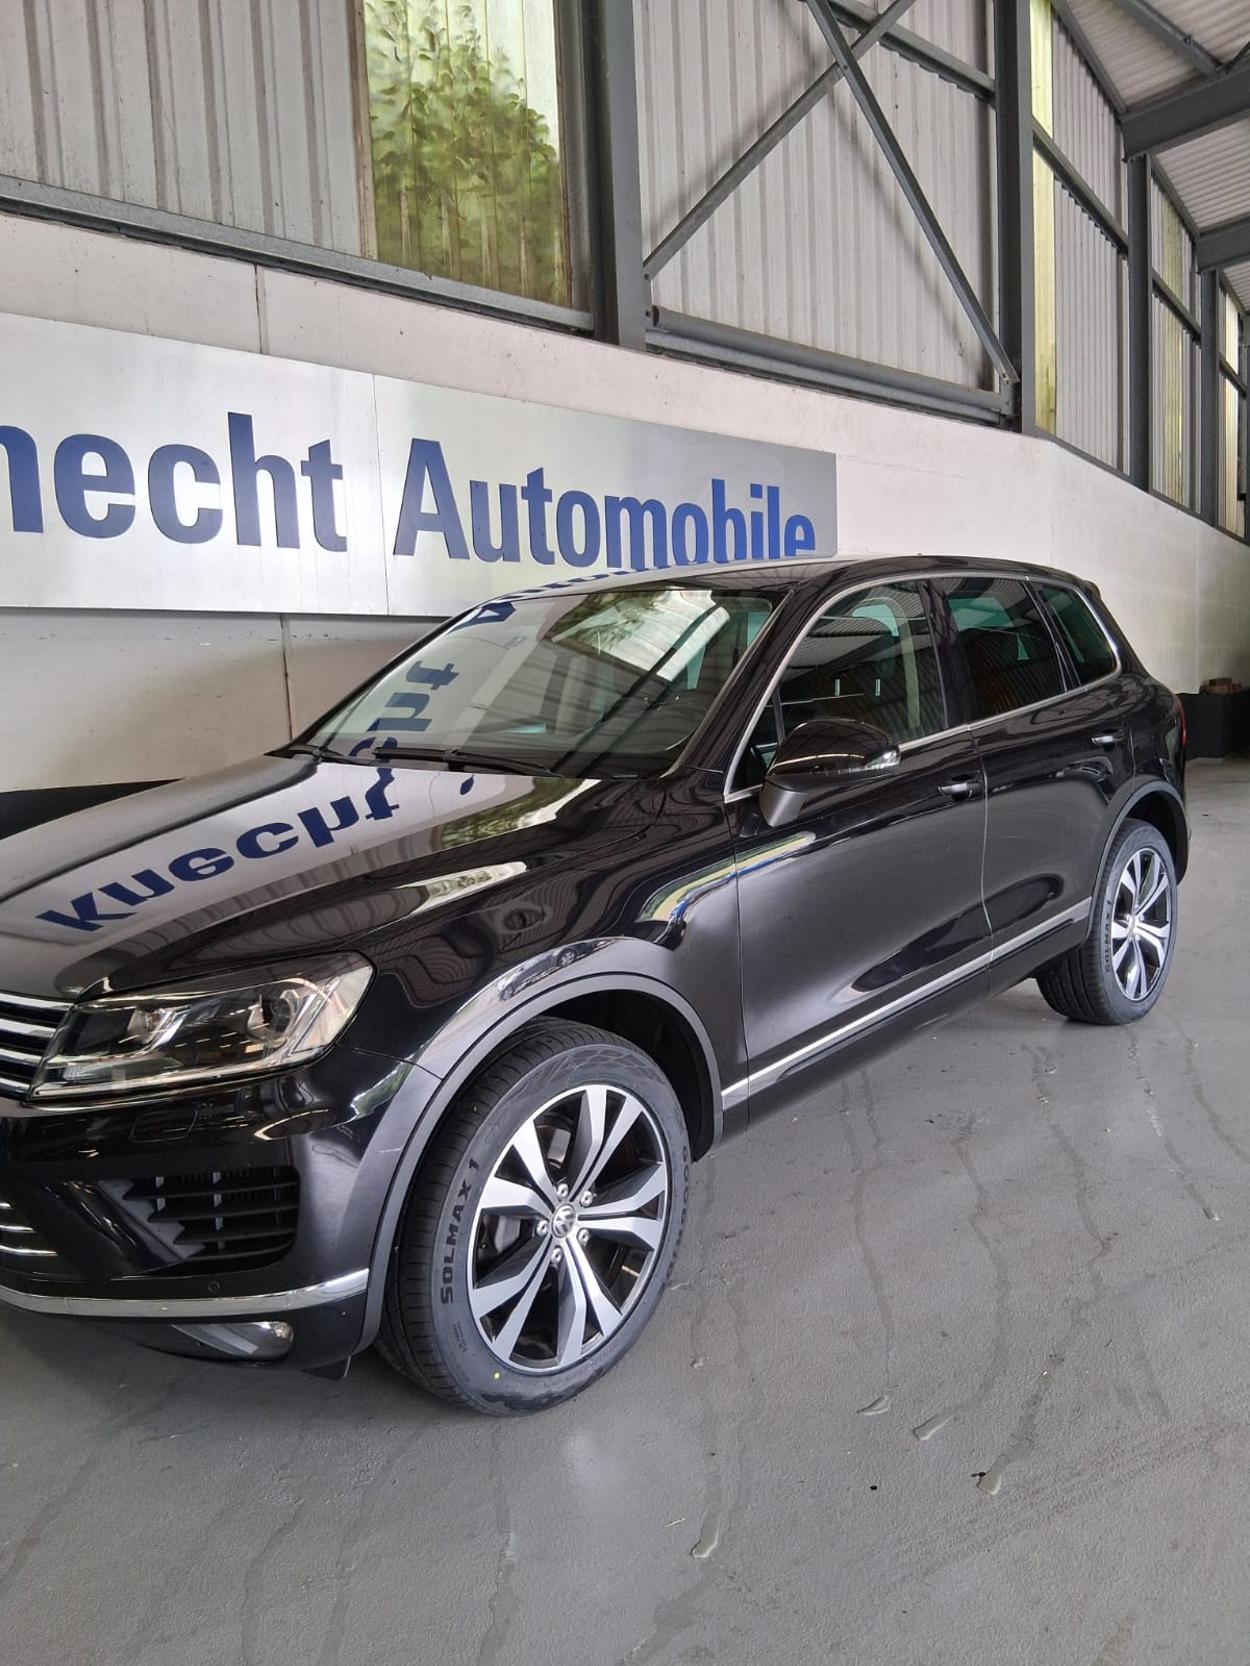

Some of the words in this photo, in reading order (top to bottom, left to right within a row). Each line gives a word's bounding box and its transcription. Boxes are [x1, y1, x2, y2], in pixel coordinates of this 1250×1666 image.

[393, 437, 816, 569] Automobile
[440, 1178, 473, 1305] SOLMAX
[467, 1157, 480, 1172] 1
